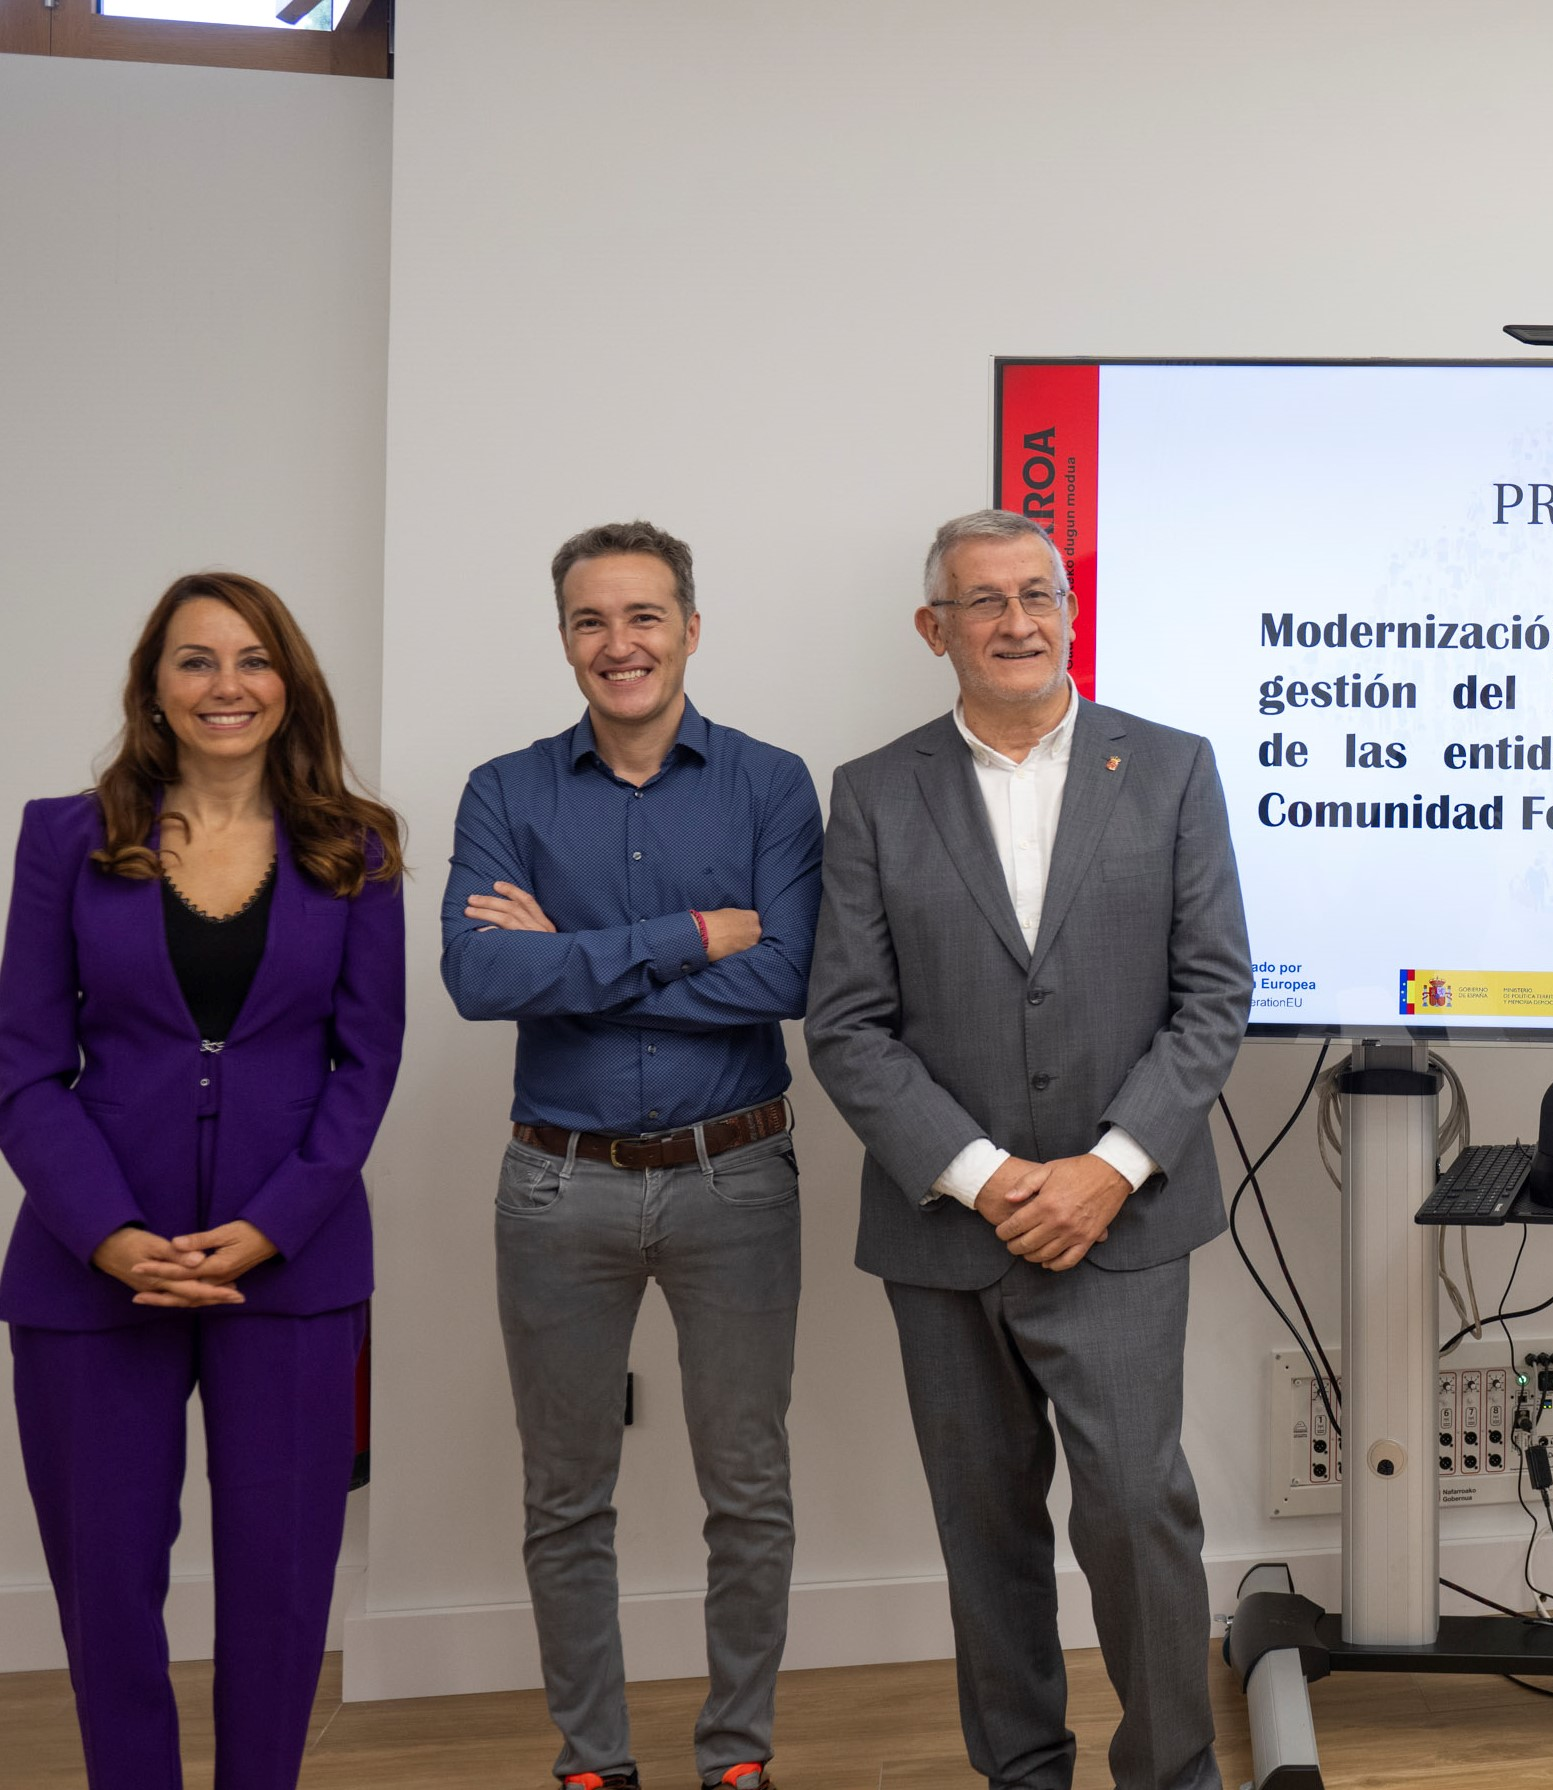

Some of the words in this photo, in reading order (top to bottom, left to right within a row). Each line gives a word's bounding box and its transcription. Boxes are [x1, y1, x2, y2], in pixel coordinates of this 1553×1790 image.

[1022, 427, 1056, 543] ROA
[1064, 456, 1077, 507] modua
[1064, 511, 1078, 556] dugun
[1259, 673, 1416, 715] gestión
[1453, 675, 1515, 709] del
[1259, 733, 1308, 767] de
[1346, 734, 1407, 768] las
[1258, 792, 1503, 830] Comunidad
[1261, 978, 1316, 992] Europea
[1280, 964, 1302, 975] por
